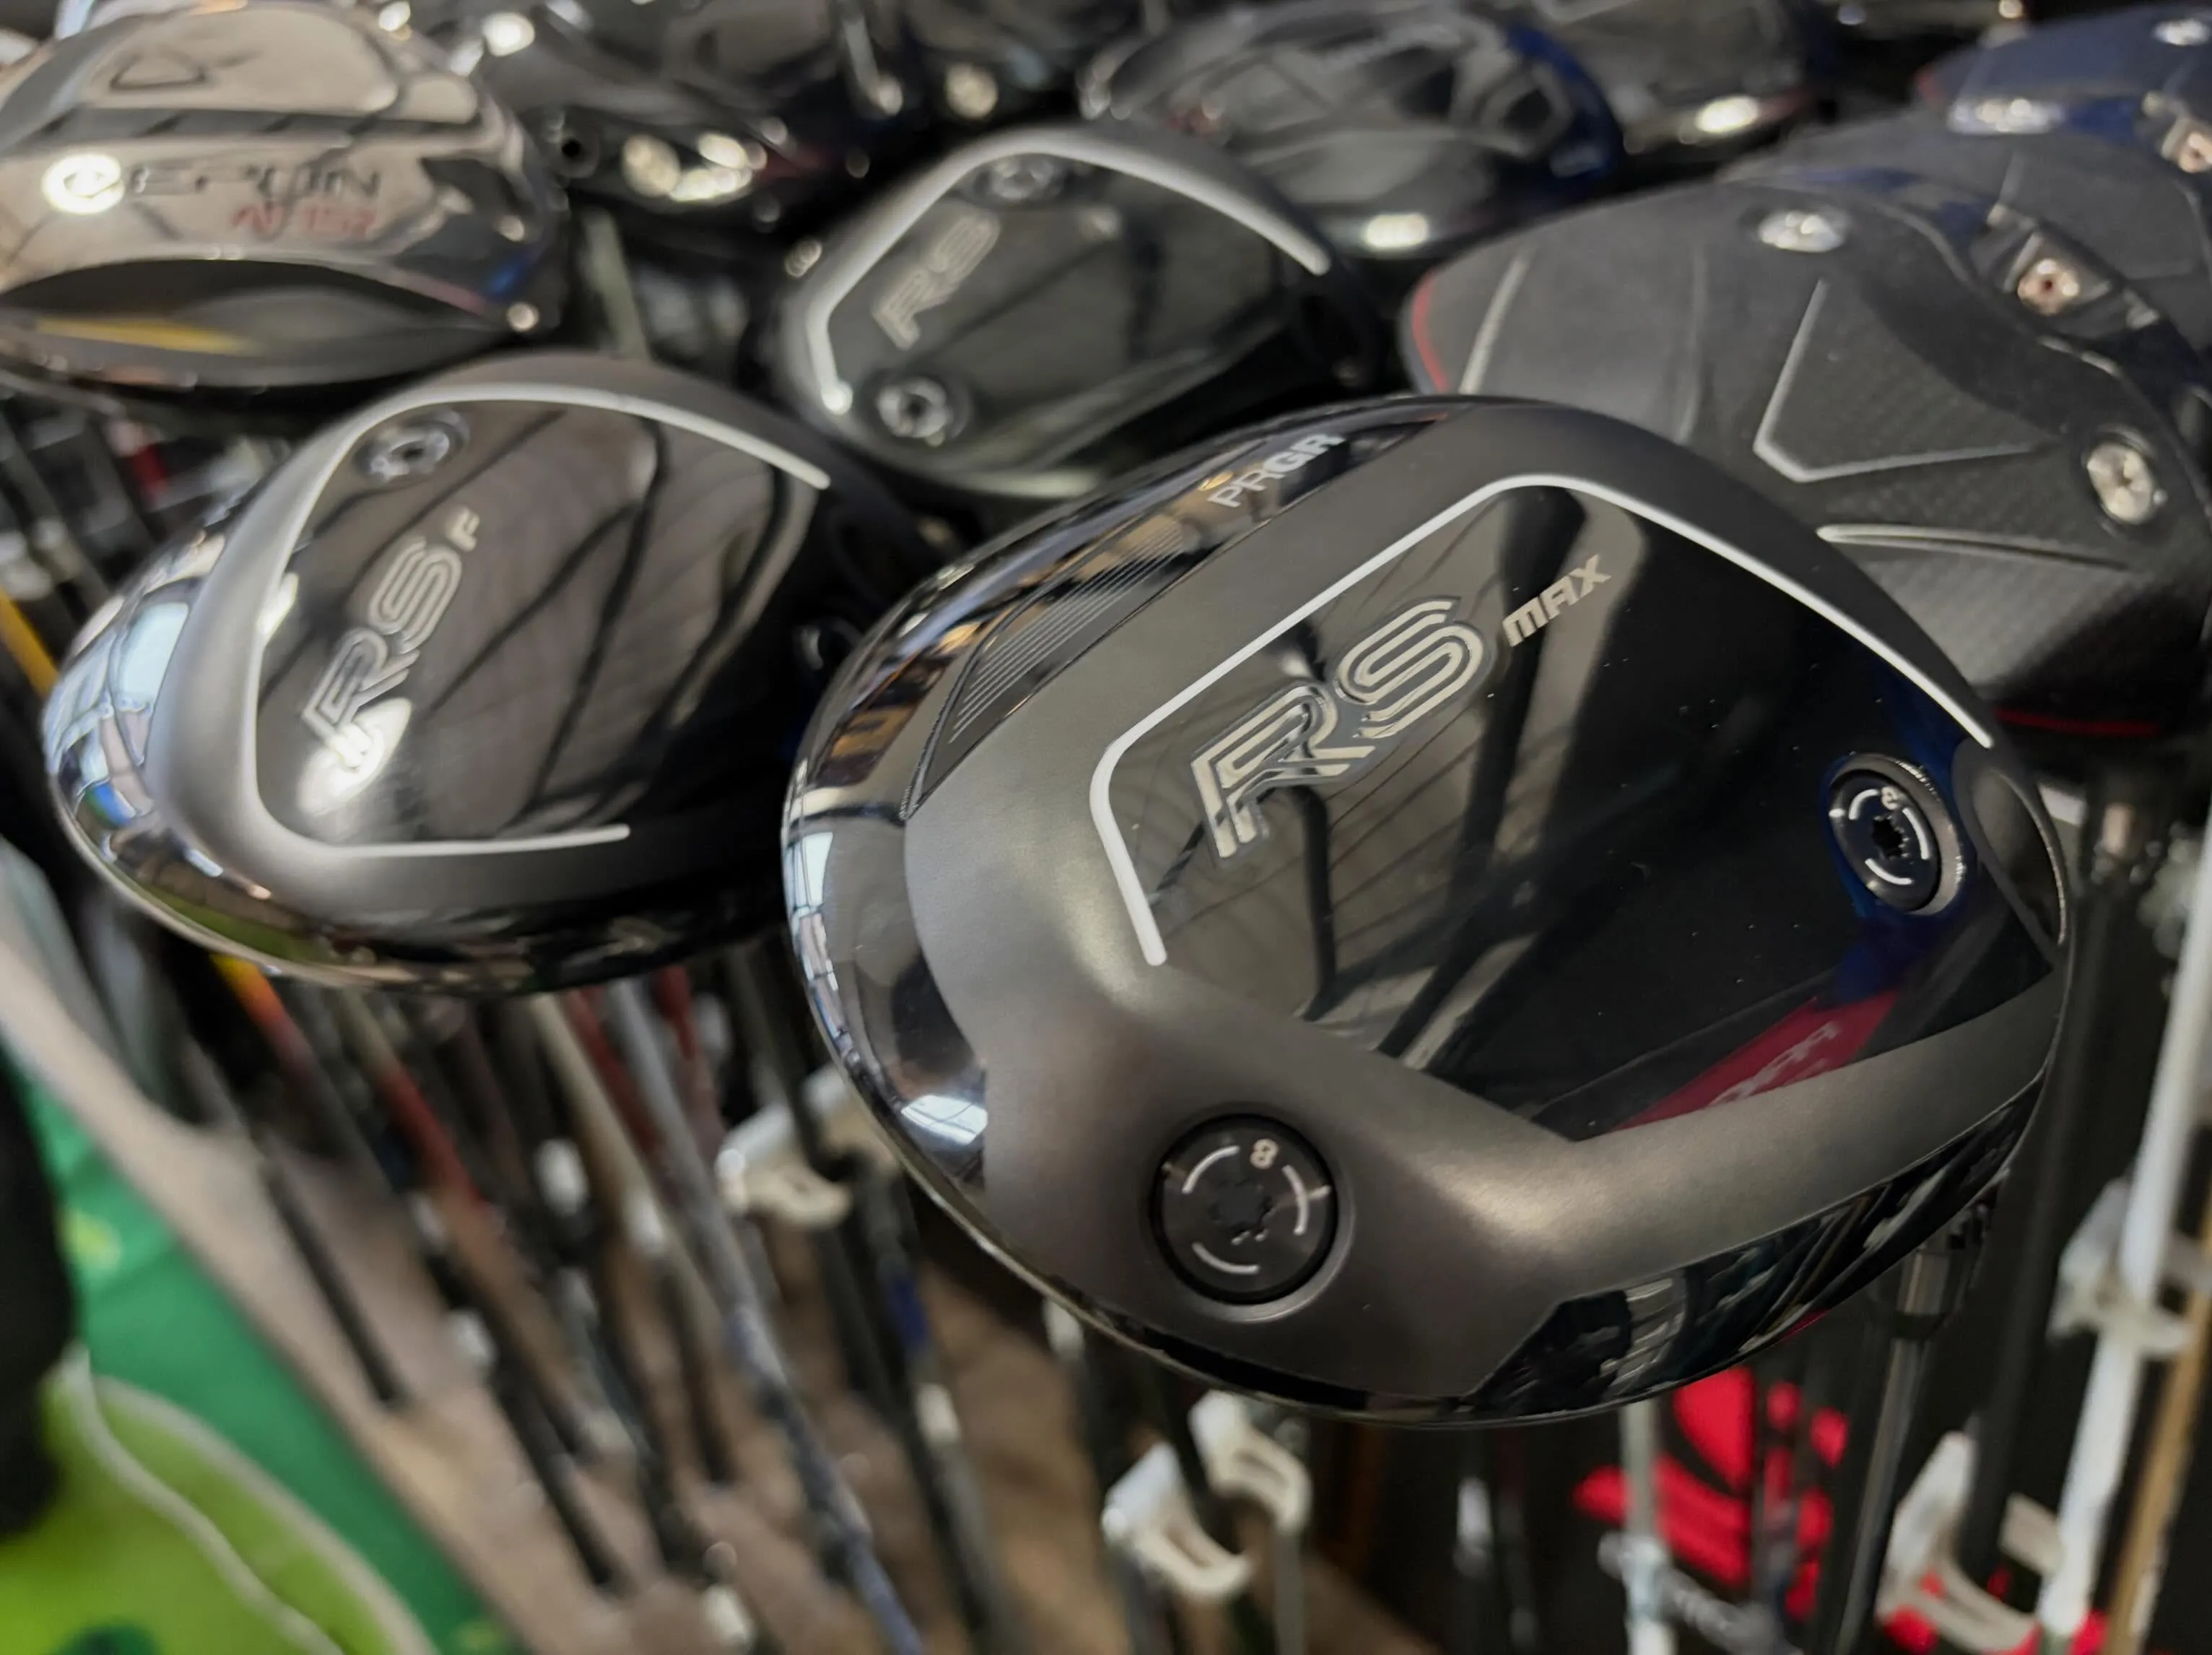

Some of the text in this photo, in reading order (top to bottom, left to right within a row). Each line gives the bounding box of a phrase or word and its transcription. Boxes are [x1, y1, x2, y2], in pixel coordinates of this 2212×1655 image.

[871, 212, 1000, 349] RS
[1206, 434, 1346, 508] PRGR
[302, 507, 480, 773] RS F
[1190, 553, 1612, 859] RS MAX
[1250, 1138, 1279, 1170] 8
